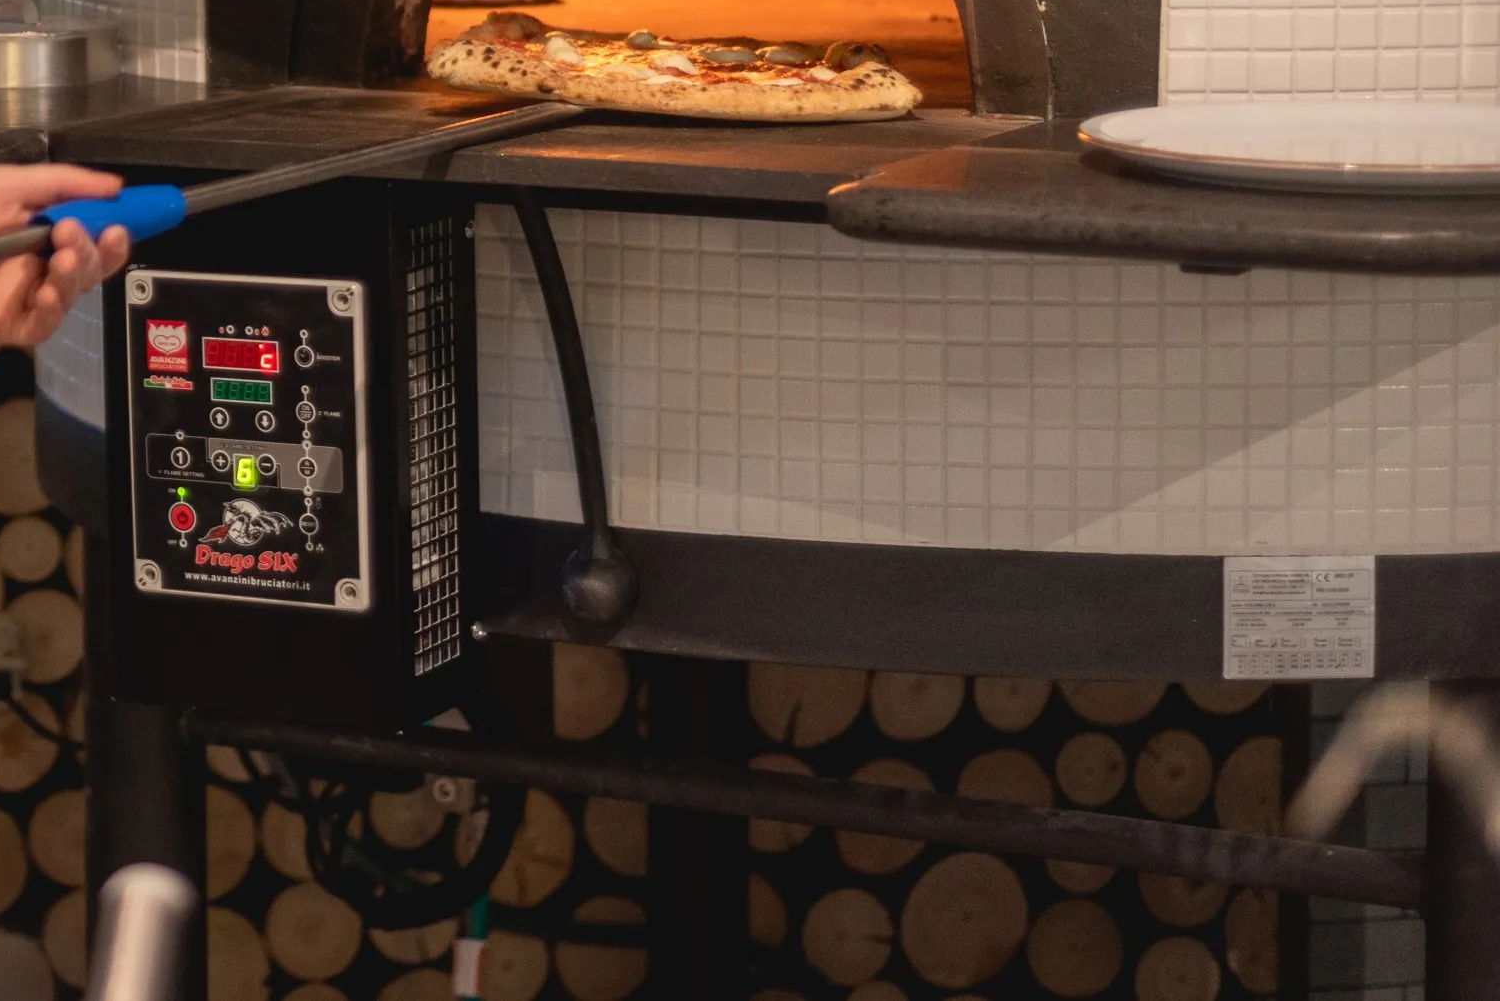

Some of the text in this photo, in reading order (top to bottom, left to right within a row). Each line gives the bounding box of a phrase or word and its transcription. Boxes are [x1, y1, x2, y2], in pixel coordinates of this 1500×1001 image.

[149, 355, 187, 365] AVANZINI
[237, 458, 253, 482] 6
[195, 544, 299, 574] Drago SIX
[183, 571, 311, 591] www.avanzinibruciatori.it
